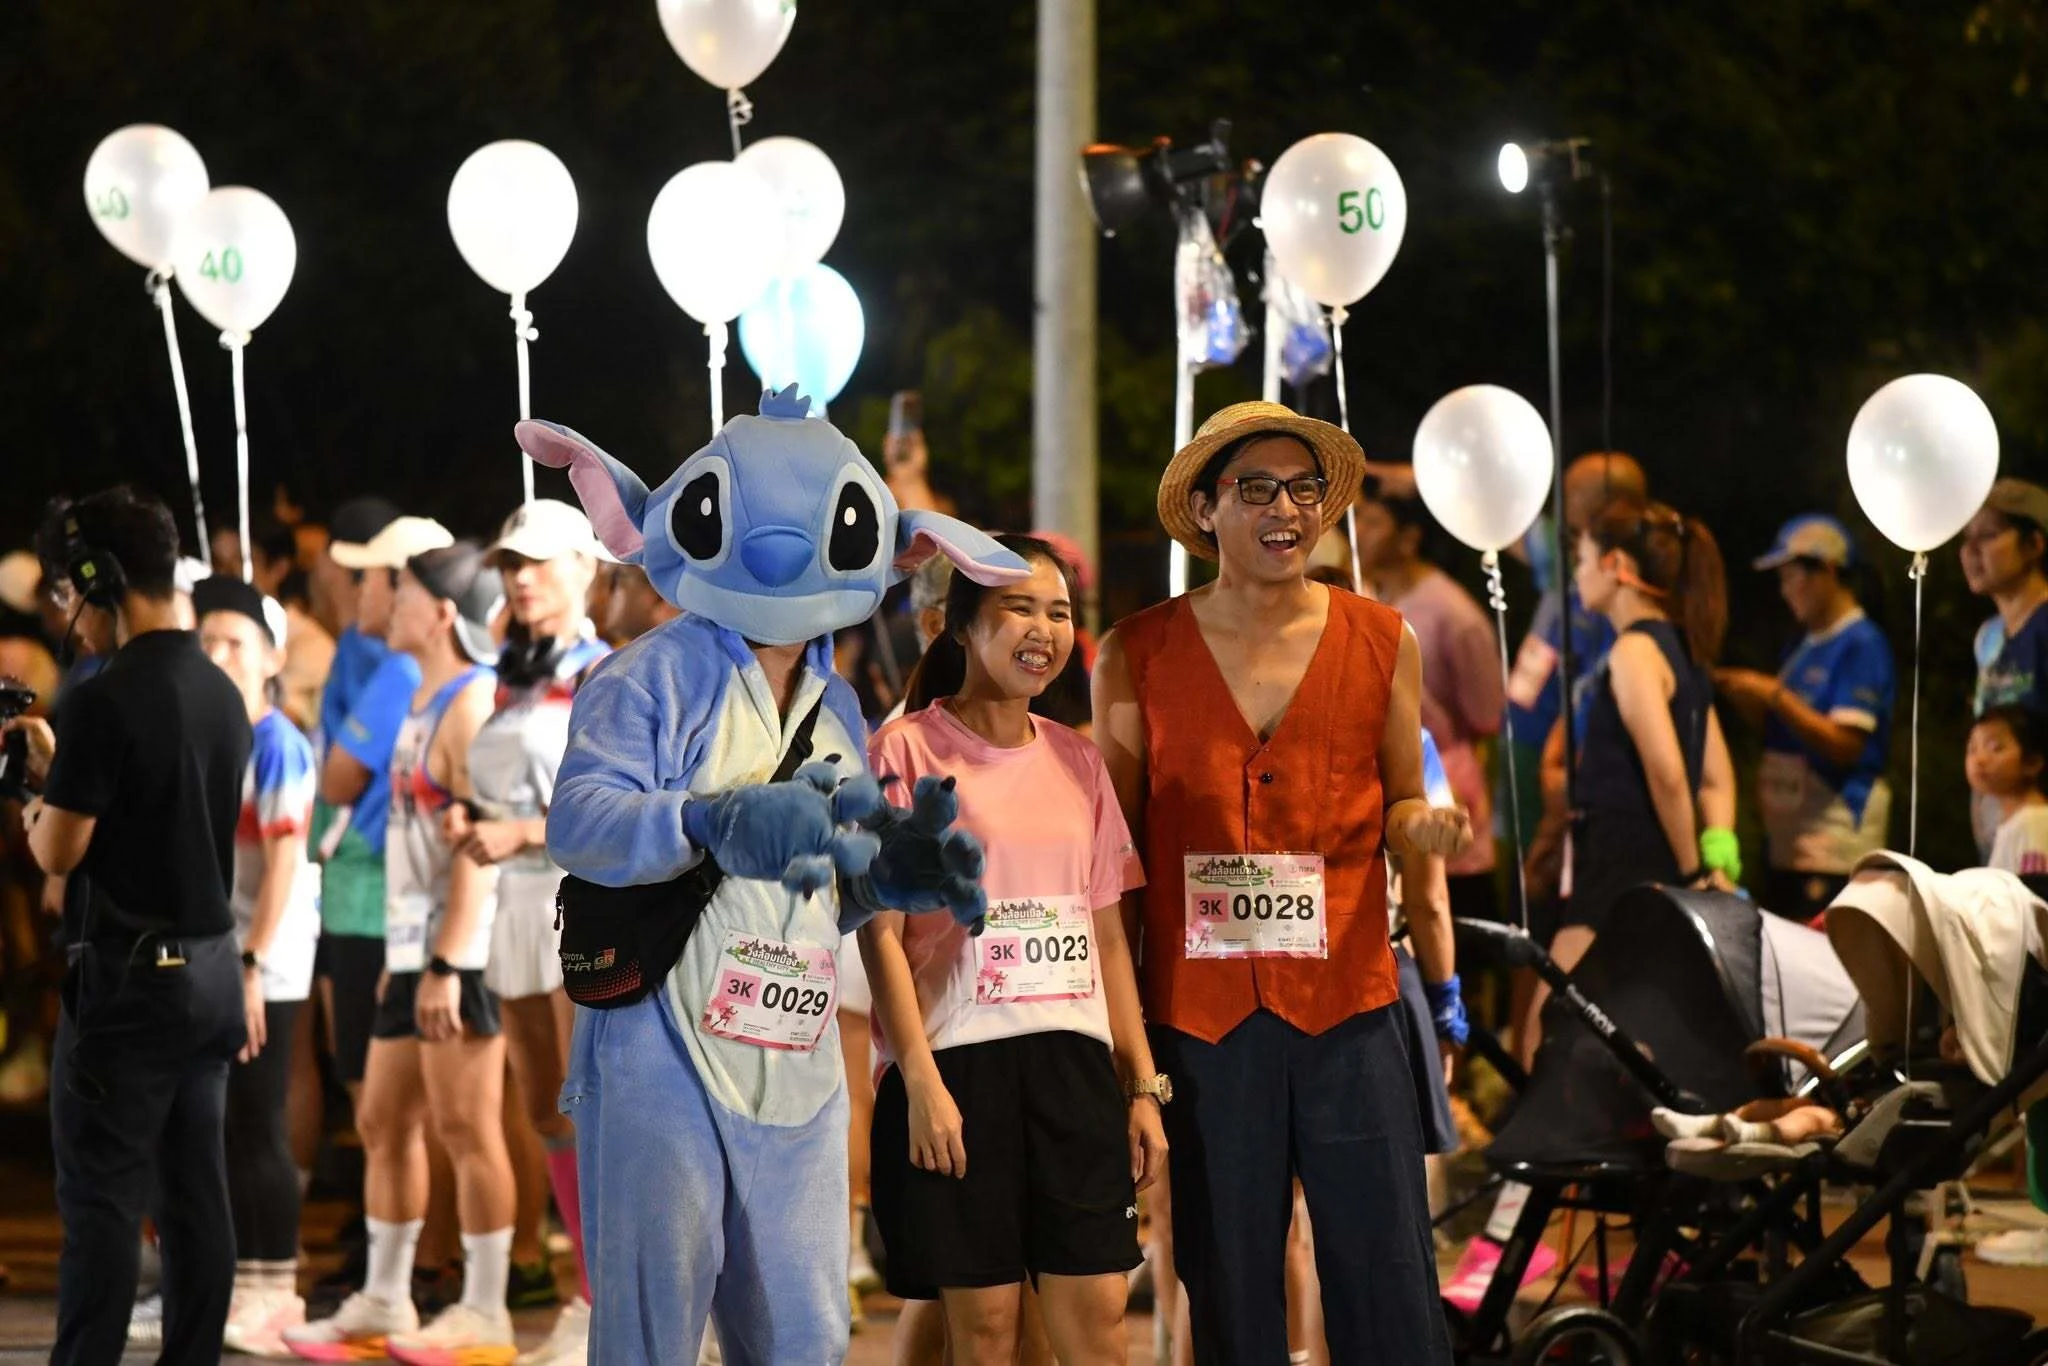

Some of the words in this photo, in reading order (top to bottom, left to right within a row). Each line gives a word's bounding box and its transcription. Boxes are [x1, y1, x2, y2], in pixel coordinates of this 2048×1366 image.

[1338, 188, 1385, 234] 50
[200, 247, 243, 284] 40
[1199, 900, 1222, 915] 3K
[1233, 894, 1314, 921] 0028
[990, 944, 1015, 961] 3K
[1025, 935, 1088, 963] 0023
[563, 962, 592, 972] -HR
[727, 979, 754, 998] 3K
[762, 983, 829, 1016] 0029
